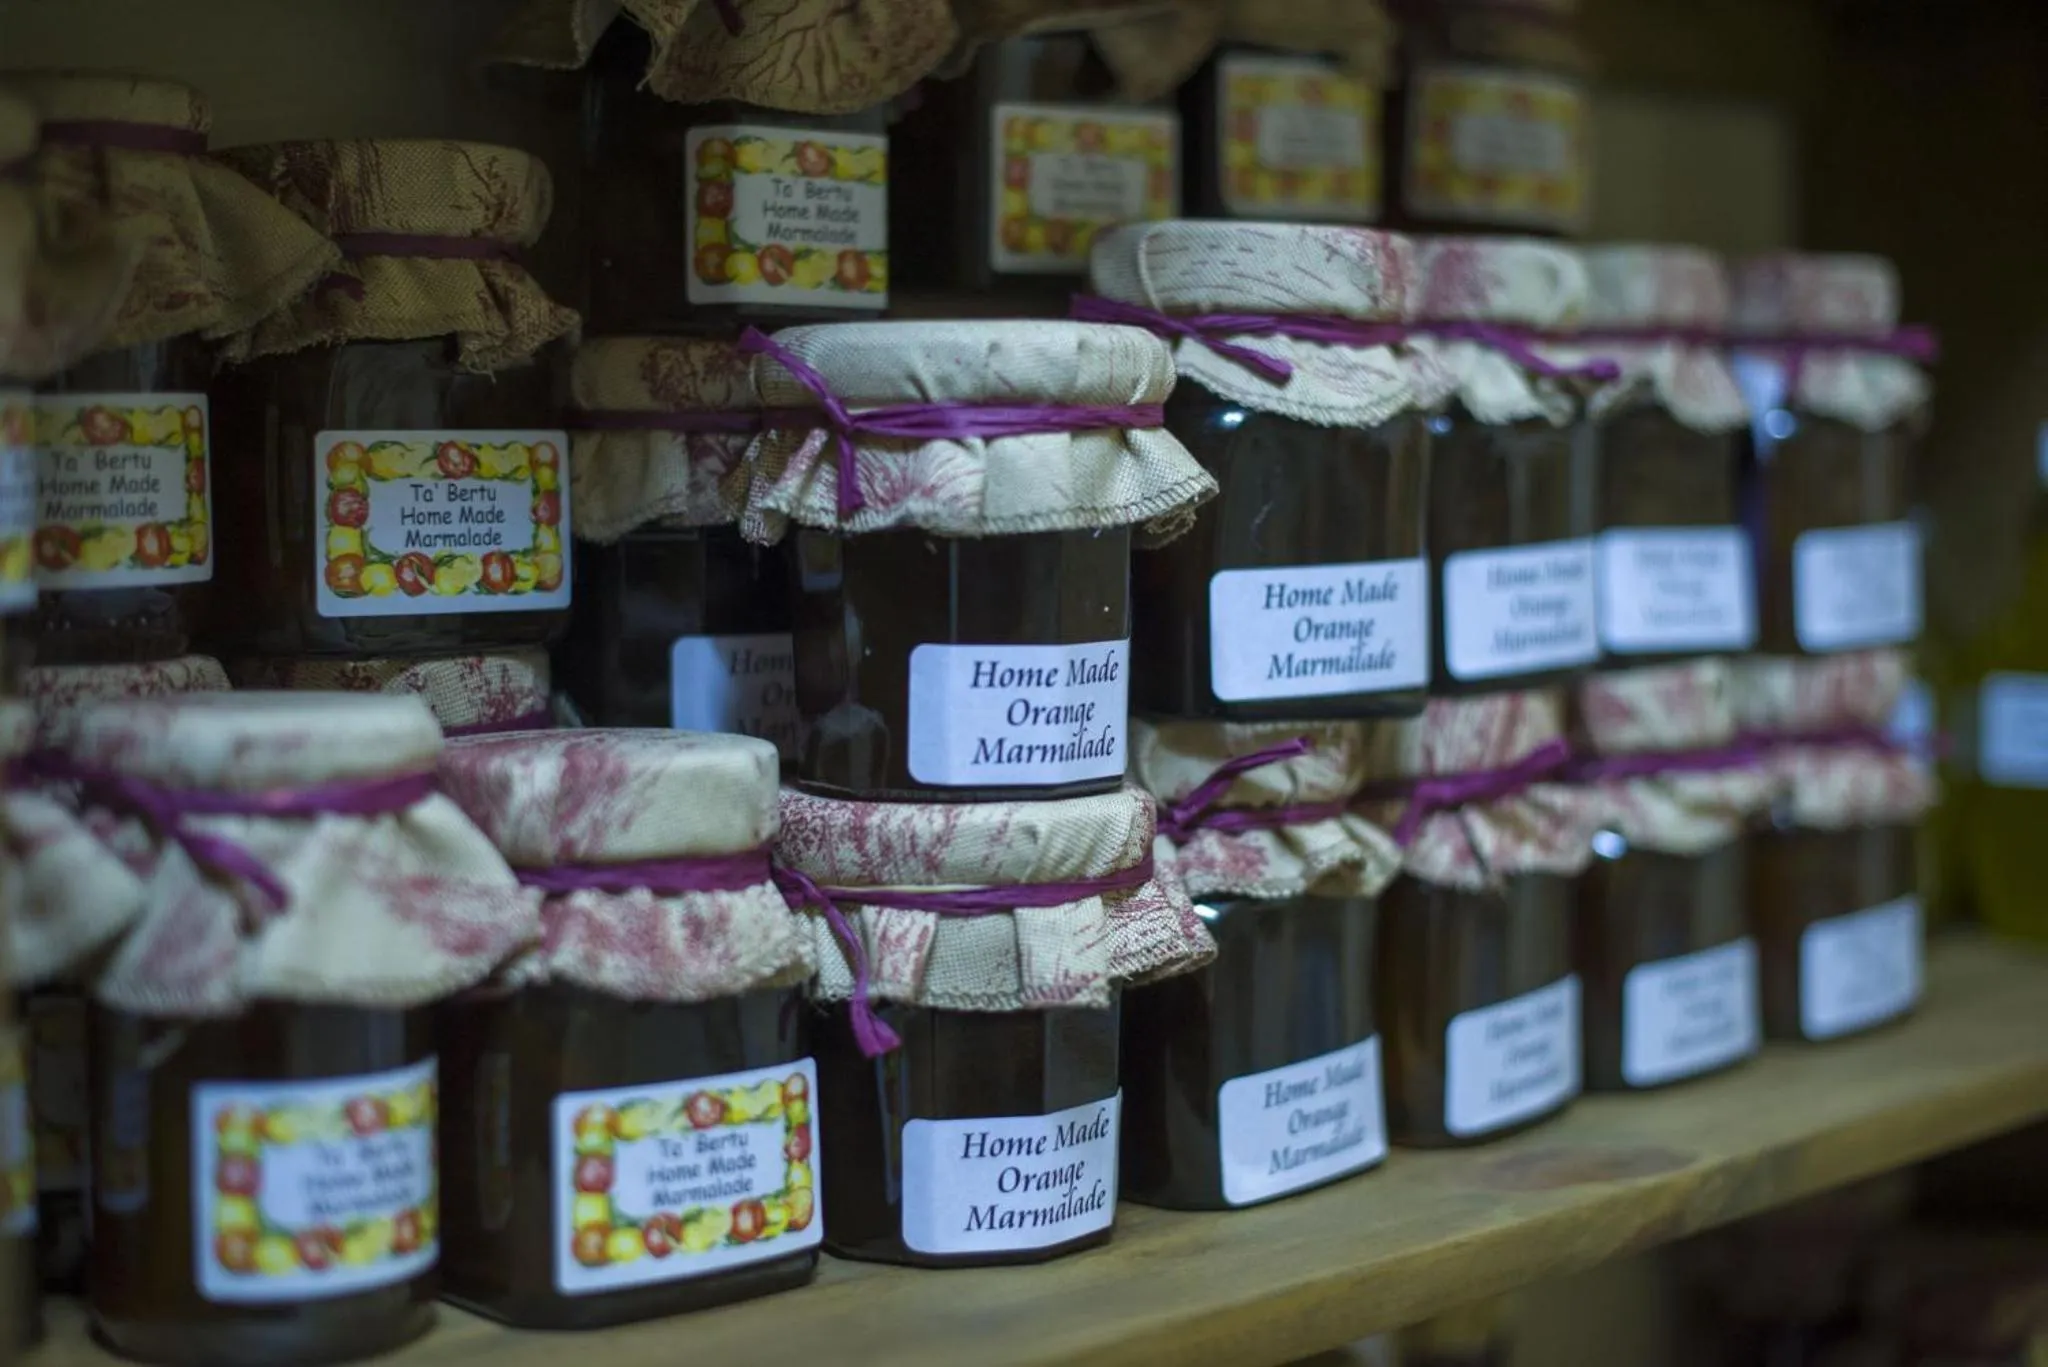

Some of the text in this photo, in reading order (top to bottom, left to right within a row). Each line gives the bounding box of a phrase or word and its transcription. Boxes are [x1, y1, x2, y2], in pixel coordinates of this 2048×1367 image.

[762, 200, 860, 224] Home Made
[766, 222, 858, 245] Marmalade
[95, 450, 152, 470] Bertu
[40, 475, 161, 496] Home Made
[410, 483, 496, 502] Ta' Bertu
[45, 498, 159, 519] Marmalade
[400, 506, 506, 526] Home Made
[405, 527, 502, 548] Marmalade
[1262, 571, 1399, 610] Home Made
[1294, 615, 1375, 650] Orange
[970, 650, 1119, 689] Home Made
[1267, 640, 1397, 680] Marmalade
[1006, 699, 1095, 737] Orange
[970, 725, 1115, 767] Marmalade
[1263, 1076, 1320, 1109] Home
[695, 1131, 749, 1153] Bertu
[961, 1107, 1110, 1159] Home Made
[646, 1152, 756, 1184] Home Made
[998, 1159, 1085, 1197] Orange
[652, 1176, 754, 1207] Marmalade
[964, 1179, 1106, 1232] Marmalade
